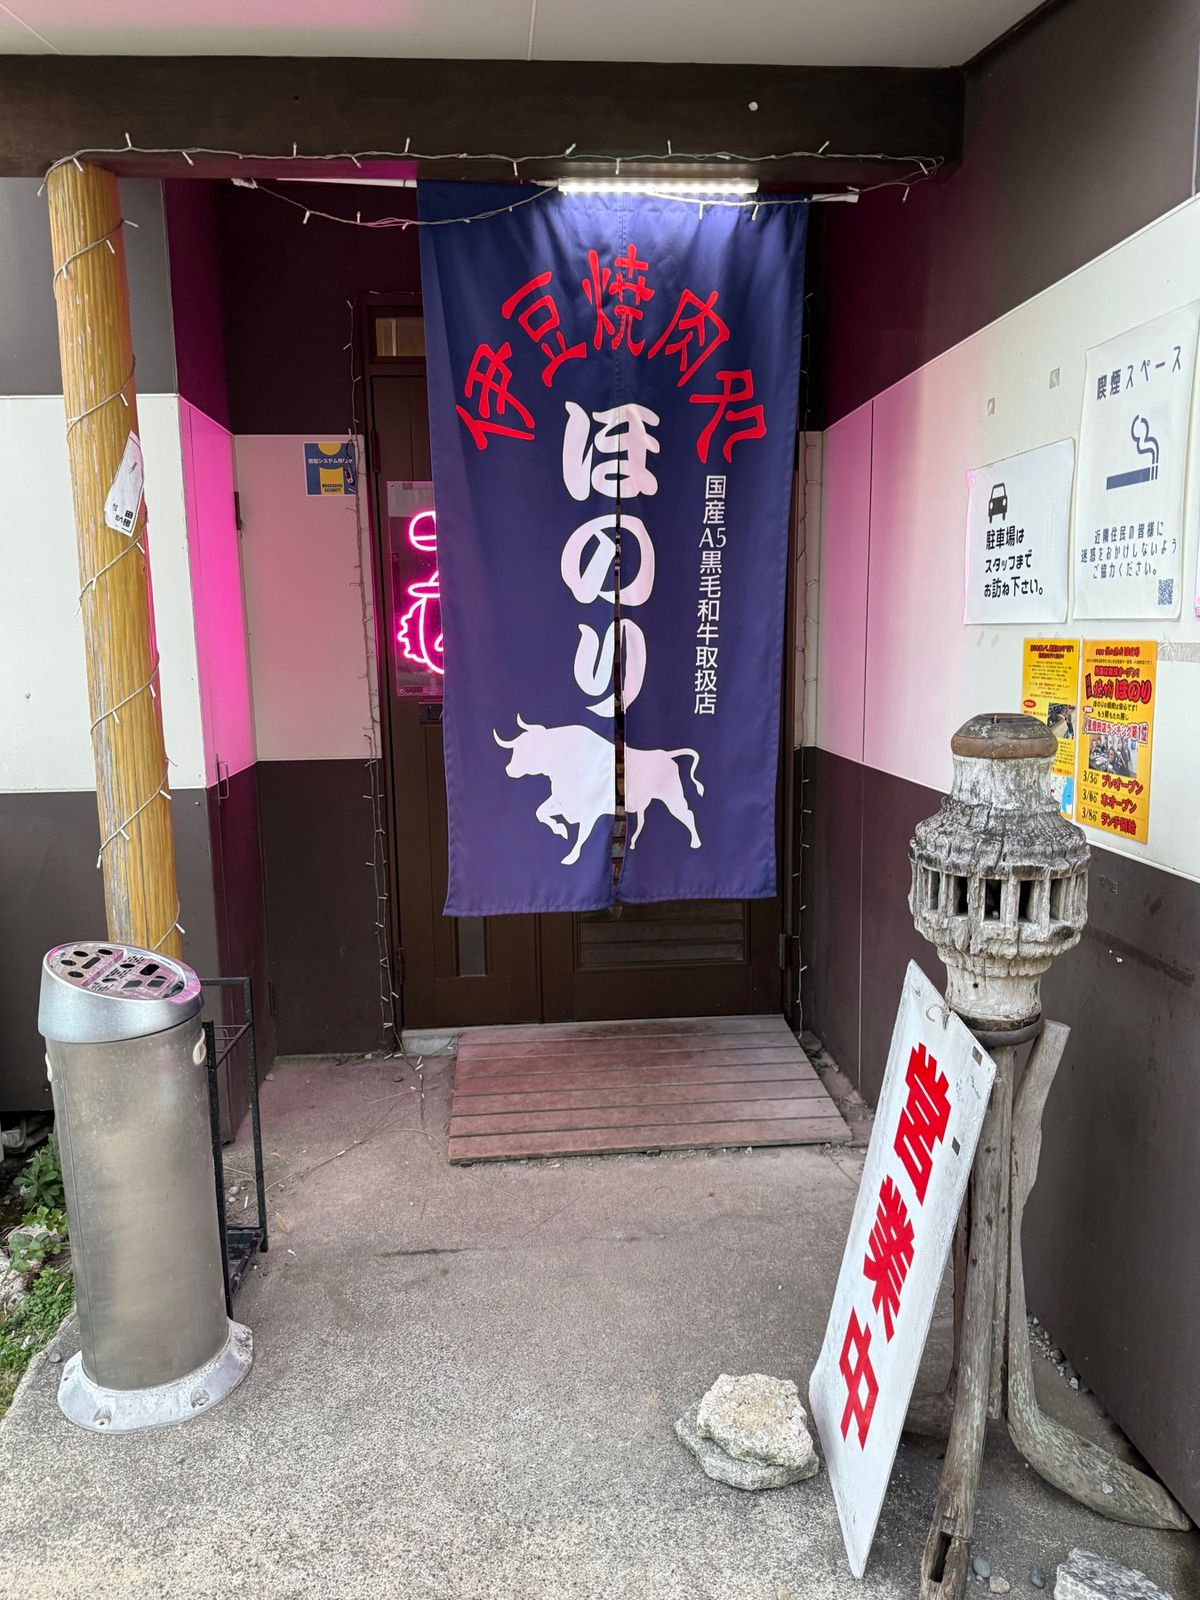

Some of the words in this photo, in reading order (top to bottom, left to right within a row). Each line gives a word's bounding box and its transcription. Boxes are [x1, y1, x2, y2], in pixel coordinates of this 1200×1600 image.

[1096, 345, 1182, 400] 喫煙スペース
[986, 525, 1025, 550] 駐車場は
[1094, 521, 1164, 544] 近隣住民の皆様に
[560, 401, 661, 718] ほのり
[985, 549, 1033, 573] スタッフまで
[1081, 538, 1177, 563] 迷惑をおかけしないよう
[1093, 561, 1157, 579] ご協力ください。
[694, 475, 727, 715] 国産A5黒毛和牛取扱店
[984, 576, 1043, 598] お訪ね下さい。
[1114, 679, 1152, 704] ほのり
[1102, 774, 1144, 795] プレオープン
[1101, 793, 1137, 814] 本オープン
[837, 1042, 952, 1452] 営業中
